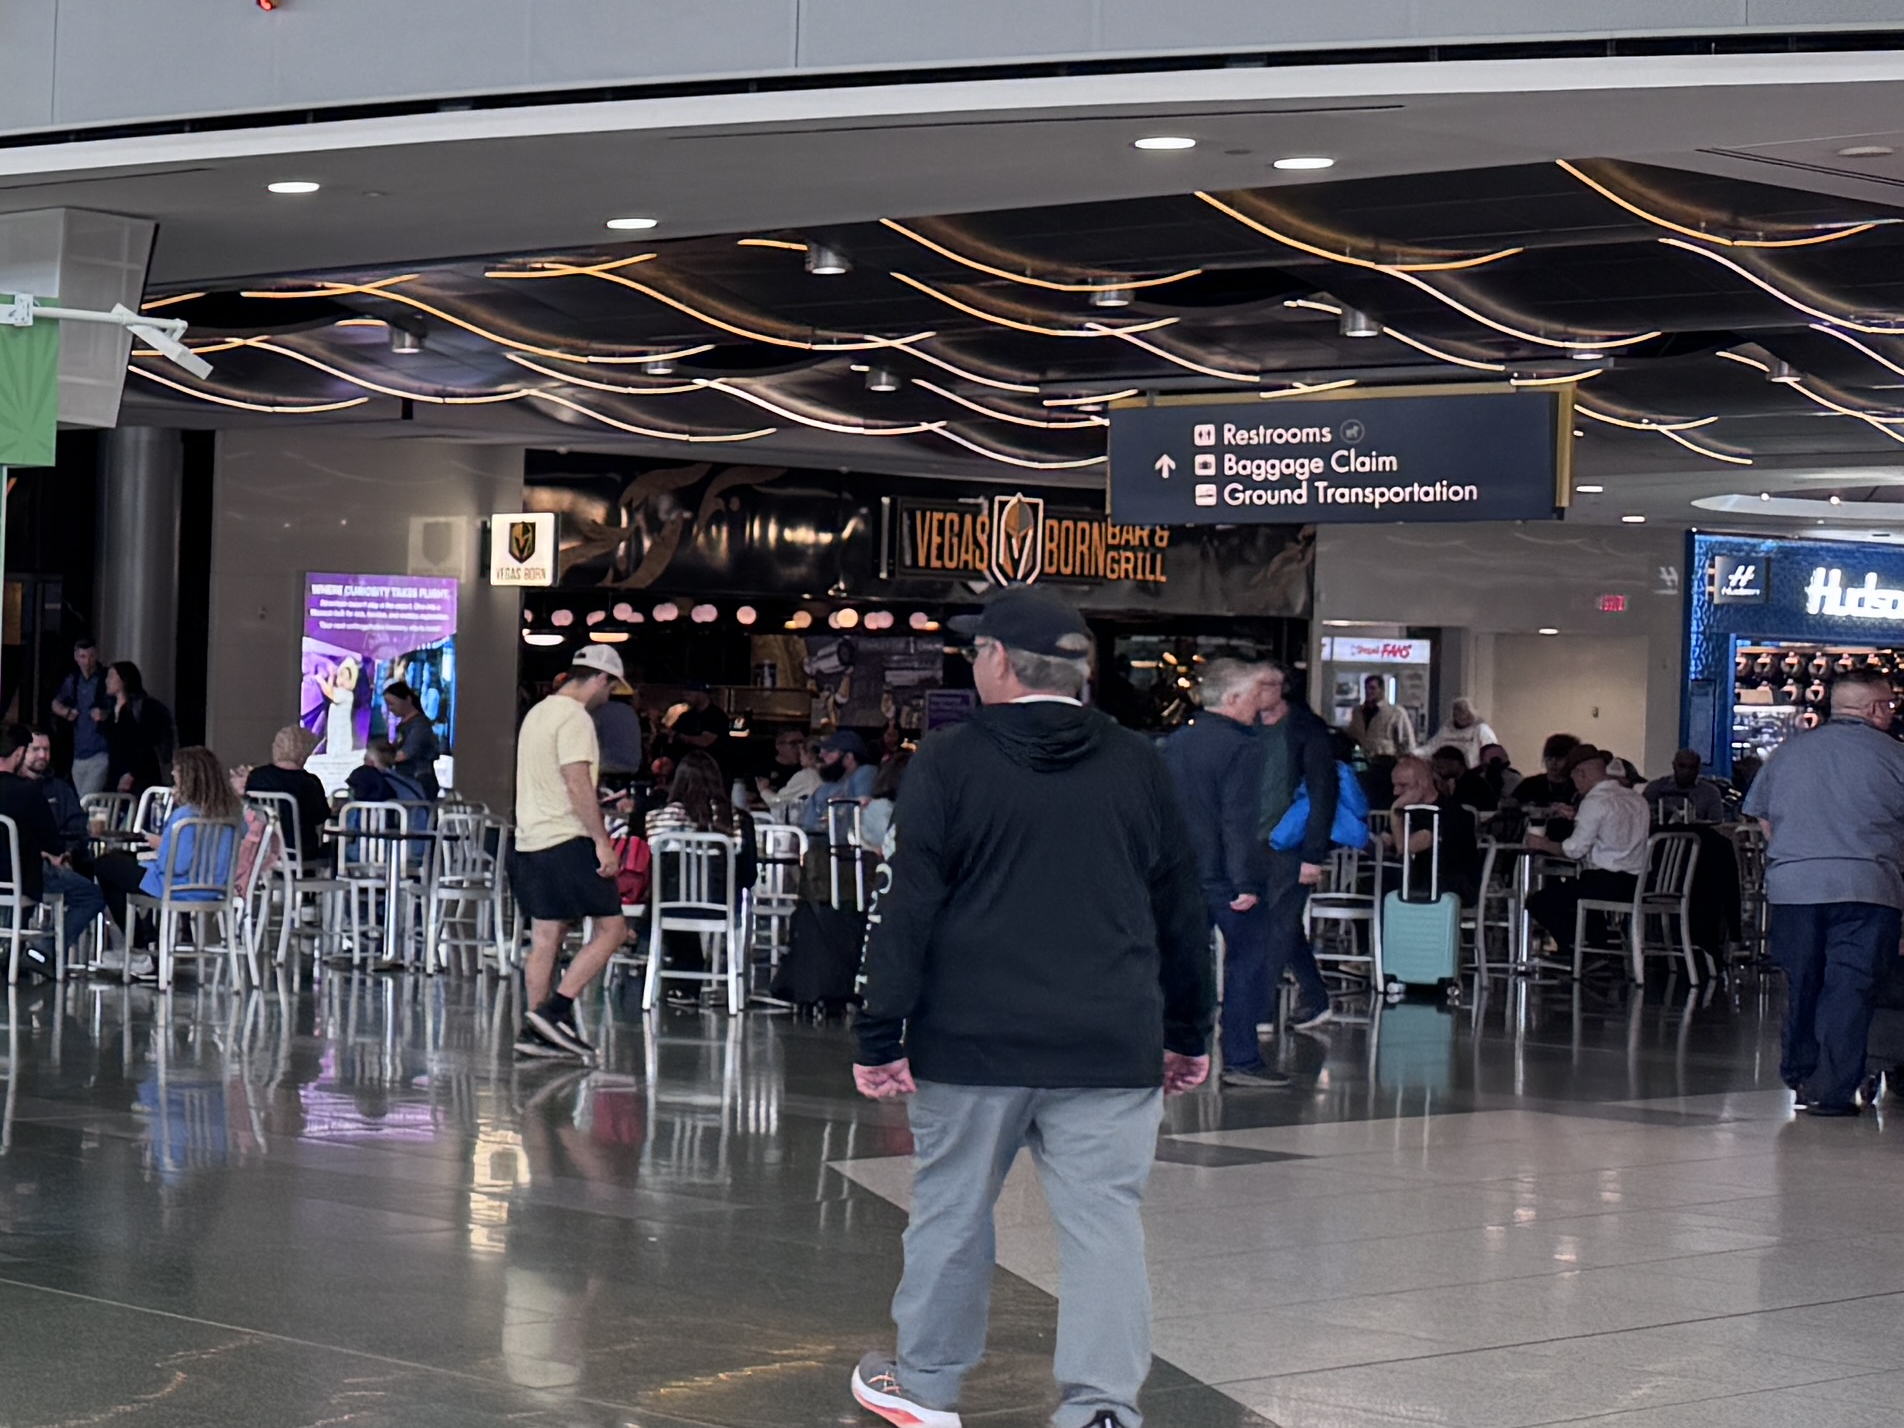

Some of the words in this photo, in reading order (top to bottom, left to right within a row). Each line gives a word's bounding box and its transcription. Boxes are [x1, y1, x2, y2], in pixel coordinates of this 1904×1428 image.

[1223, 423, 1332, 446] Restrooms
[1224, 455, 1324, 481] Baggage
[1331, 448, 1398, 473] Claim
[1224, 483, 1307, 506] Ground
[1314, 481, 1478, 509] Transportation
[916, 511, 990, 571] VEGAS
[1044, 520, 1107, 576] BORN
[496, 567, 522, 580] VEGAS
[1106, 551, 1168, 583] GRILL
